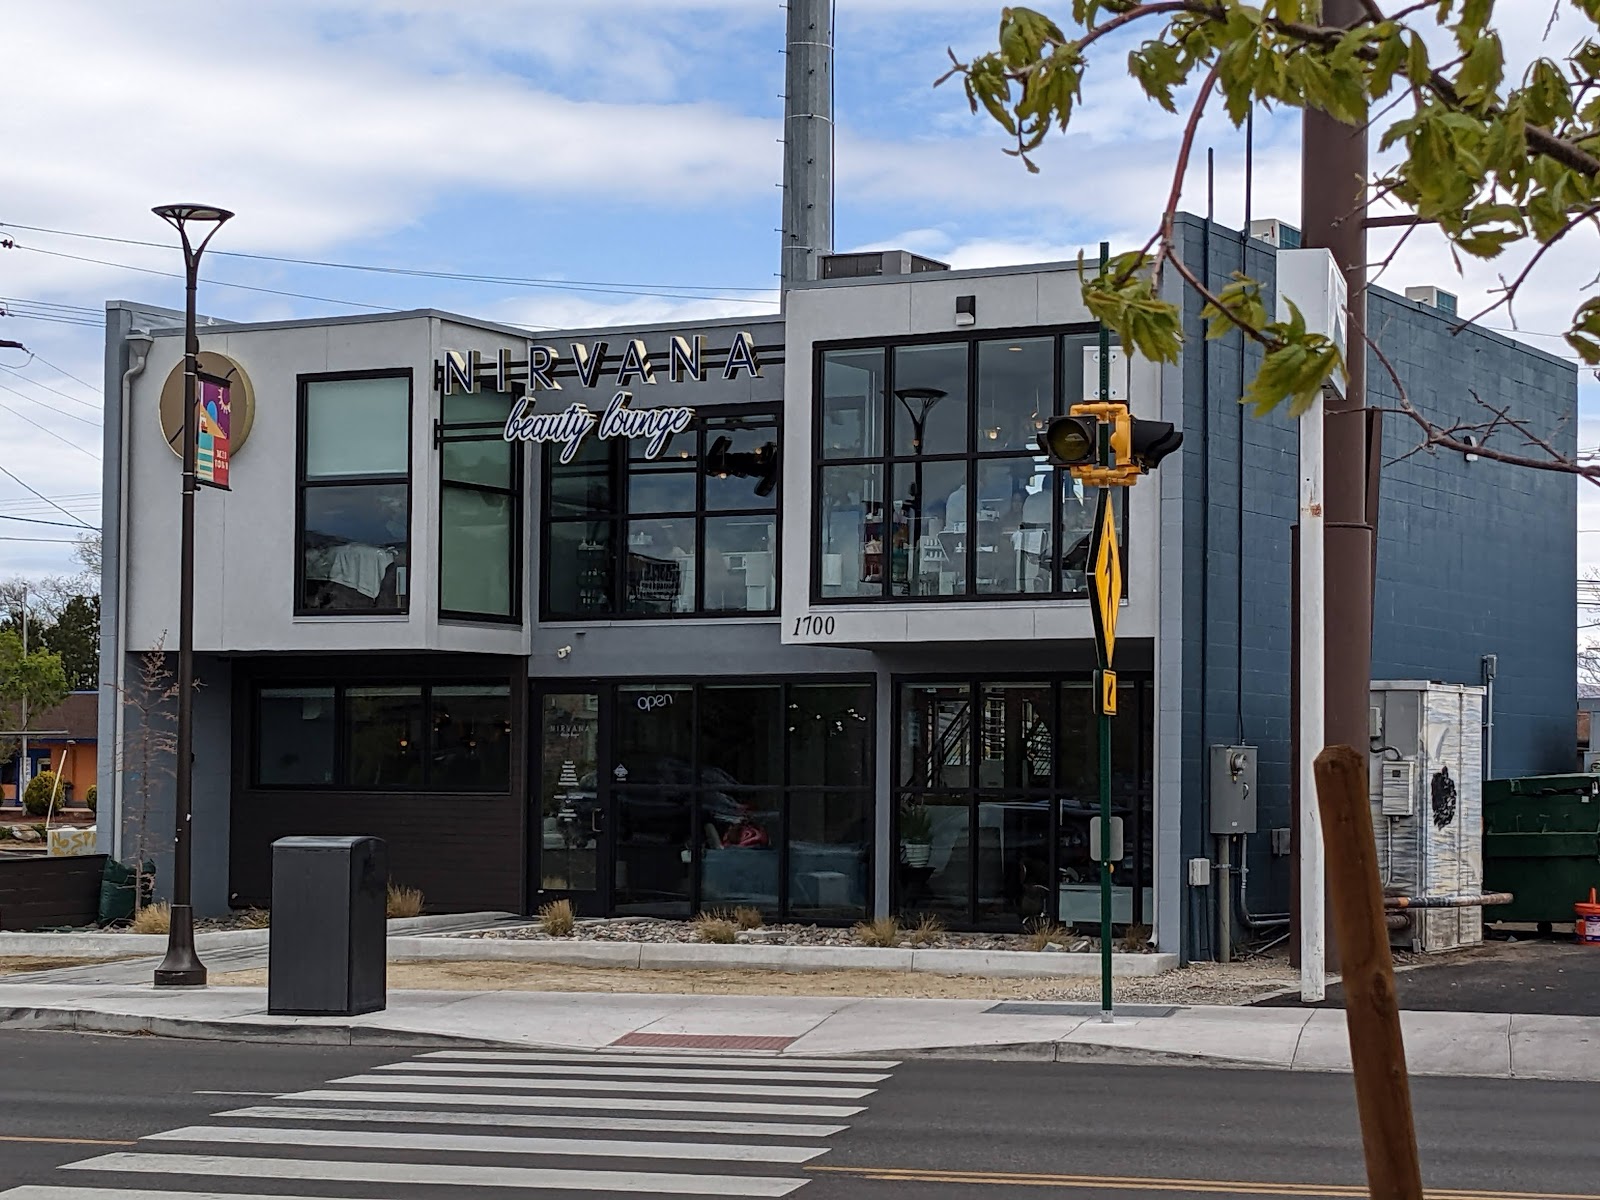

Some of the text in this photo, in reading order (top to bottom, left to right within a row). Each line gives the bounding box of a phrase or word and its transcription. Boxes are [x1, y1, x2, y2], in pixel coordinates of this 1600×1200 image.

[444, 332, 761, 395] NIRVANA
[504, 391, 692, 464] beauty lounge
[792, 615, 835, 636] 1700
[637, 693, 673, 711] open
